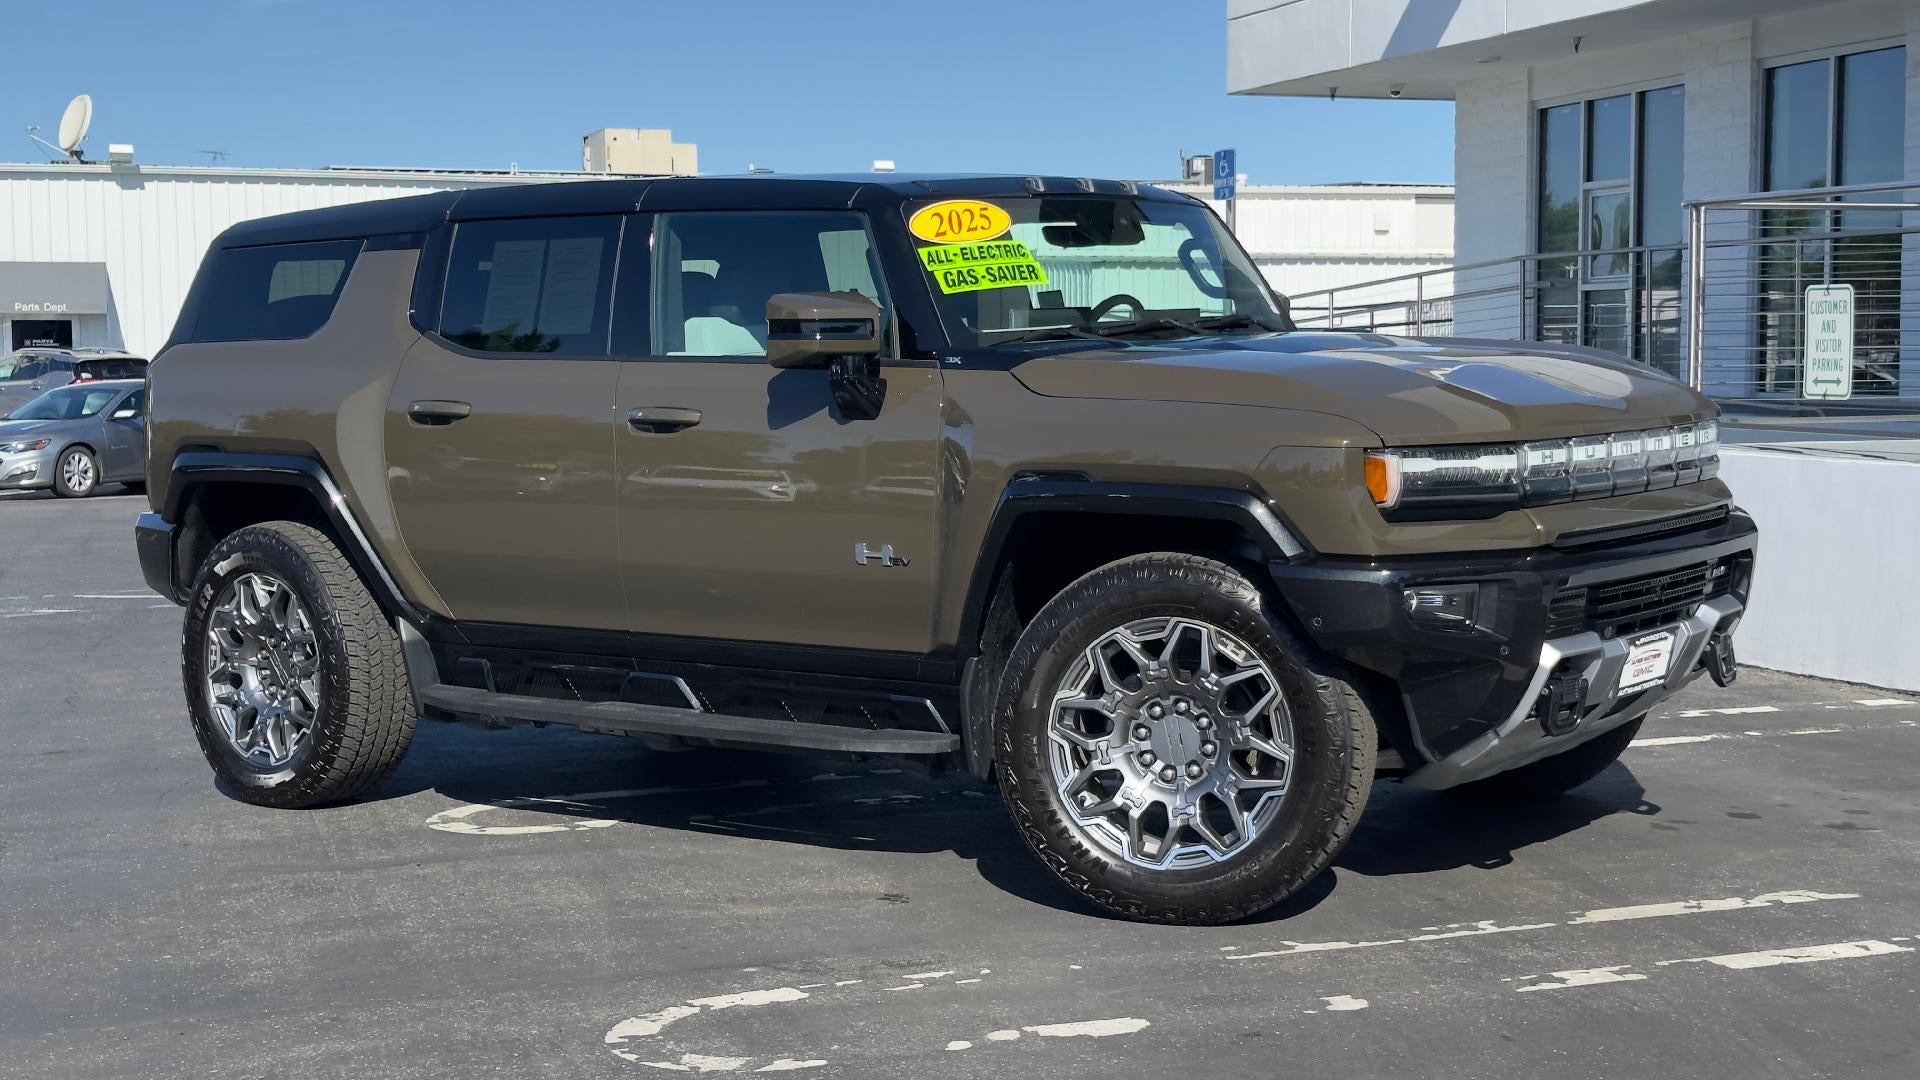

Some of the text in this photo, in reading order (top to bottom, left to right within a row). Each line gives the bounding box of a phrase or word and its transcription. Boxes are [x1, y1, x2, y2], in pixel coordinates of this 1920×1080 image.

[930, 207, 992, 237] 2025
[926, 244, 1027, 266] ALL-ELECTRIC
[943, 264, 1039, 289] GAS-SAVER
[14, 302, 70, 313] Parts Dept.
[1810, 300, 1848, 315] CUSTOMER
[1821, 320, 1837, 334] AND
[1815, 338, 1842, 353] VISITOR
[1812, 358, 1844, 372] PARKING
[1541, 430, 1711, 463] HUMMER
